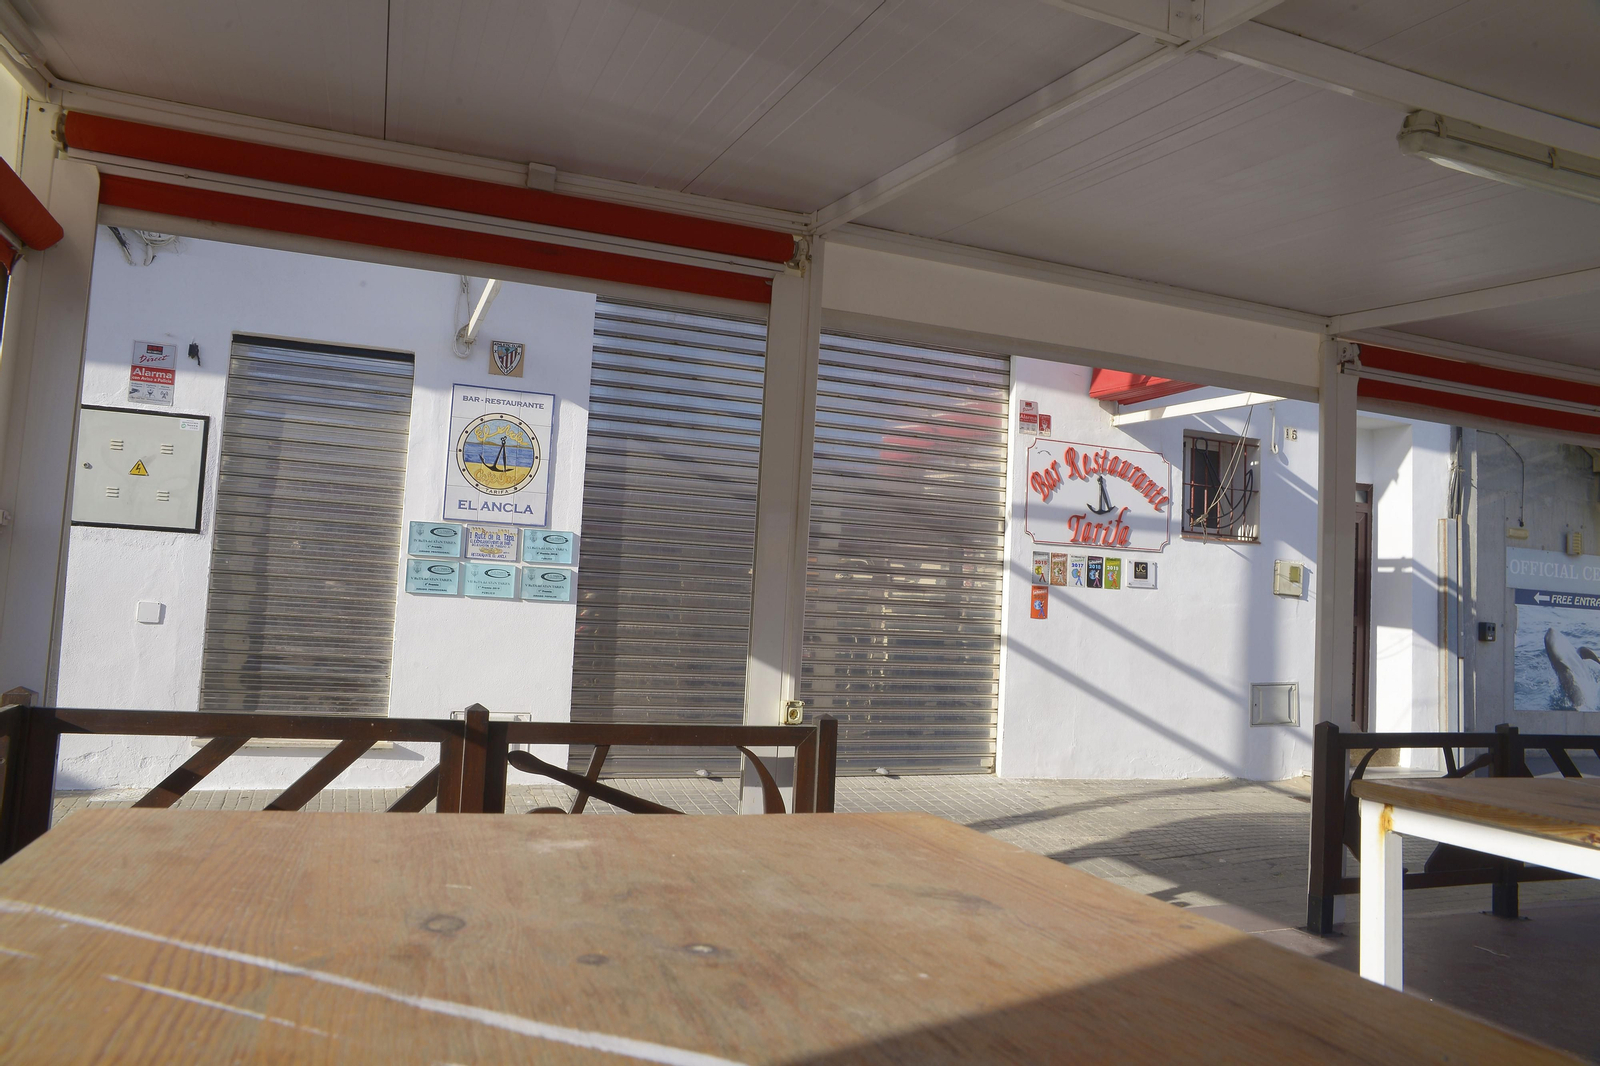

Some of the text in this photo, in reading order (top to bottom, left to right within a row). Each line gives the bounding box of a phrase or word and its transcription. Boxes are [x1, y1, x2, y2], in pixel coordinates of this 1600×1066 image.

[139, 354, 170, 364] Direct
[132, 367, 172, 379] Alarma
[462, 395, 480, 403] BAR
[484, 397, 545, 410] RESTAURANTE
[1030, 446, 1169, 511] Bar Restaurante
[457, 499, 534, 515] EL ANCLA
[1067, 506, 1130, 547] Tarifa
[474, 531, 486, 540] Ruta
[487, 533, 494, 541] de
[503, 533, 515, 543] Tapa
[1135, 563, 1146, 573] JC
[1509, 558, 1579, 580] OFFICIAL
[1551, 594, 1573, 605] FREE
